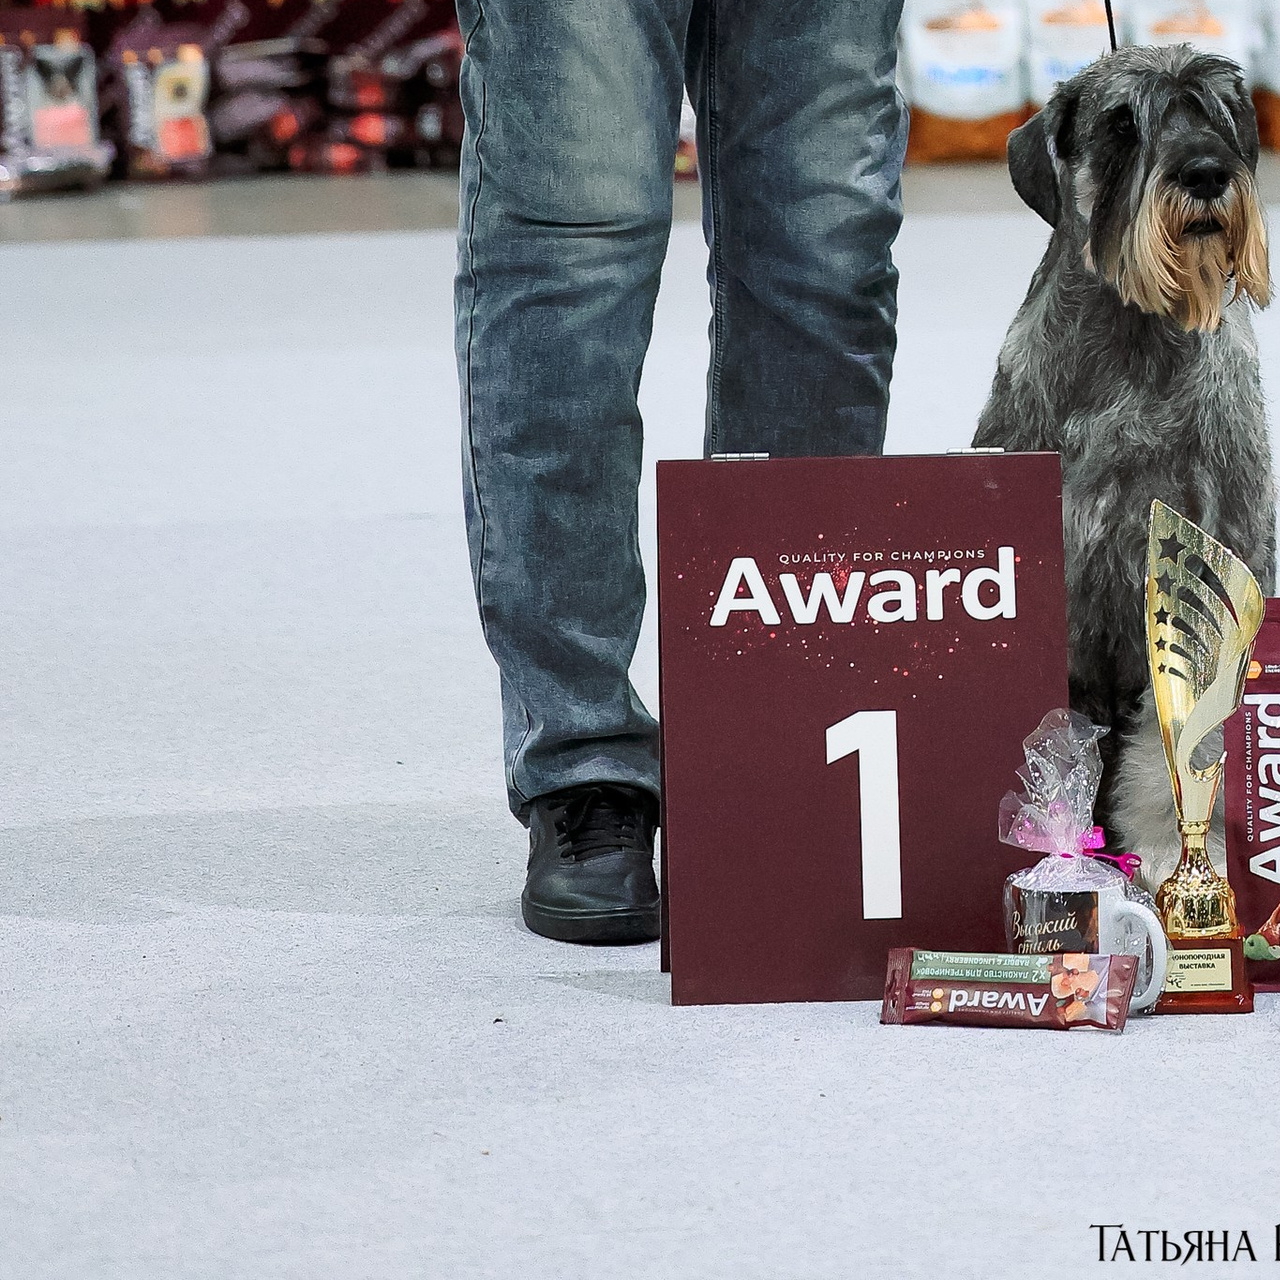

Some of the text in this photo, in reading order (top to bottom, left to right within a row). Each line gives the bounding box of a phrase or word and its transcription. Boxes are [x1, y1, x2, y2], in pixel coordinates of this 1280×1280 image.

[779, 549, 985, 564] QUALITY FOR CHAMPIONS
[710, 546, 1017, 626] Award
[1245, 711, 1253, 770] CHAMPIONS
[825, 710, 902, 920] 1
[1246, 798, 1254, 842] QUALITY
[1012, 910, 1078, 940] Высокий
[1018, 939, 1063, 954] стиль
[915, 967, 964, 976] ТРЕНИРОВОК
[966, 968, 981, 977] ДЛЯ
[983, 970, 1029, 979] ЛАКОМСТВО
[1178, 962, 1216, 970] ВЫСТАВКА
[948, 989, 1050, 1017] Award
